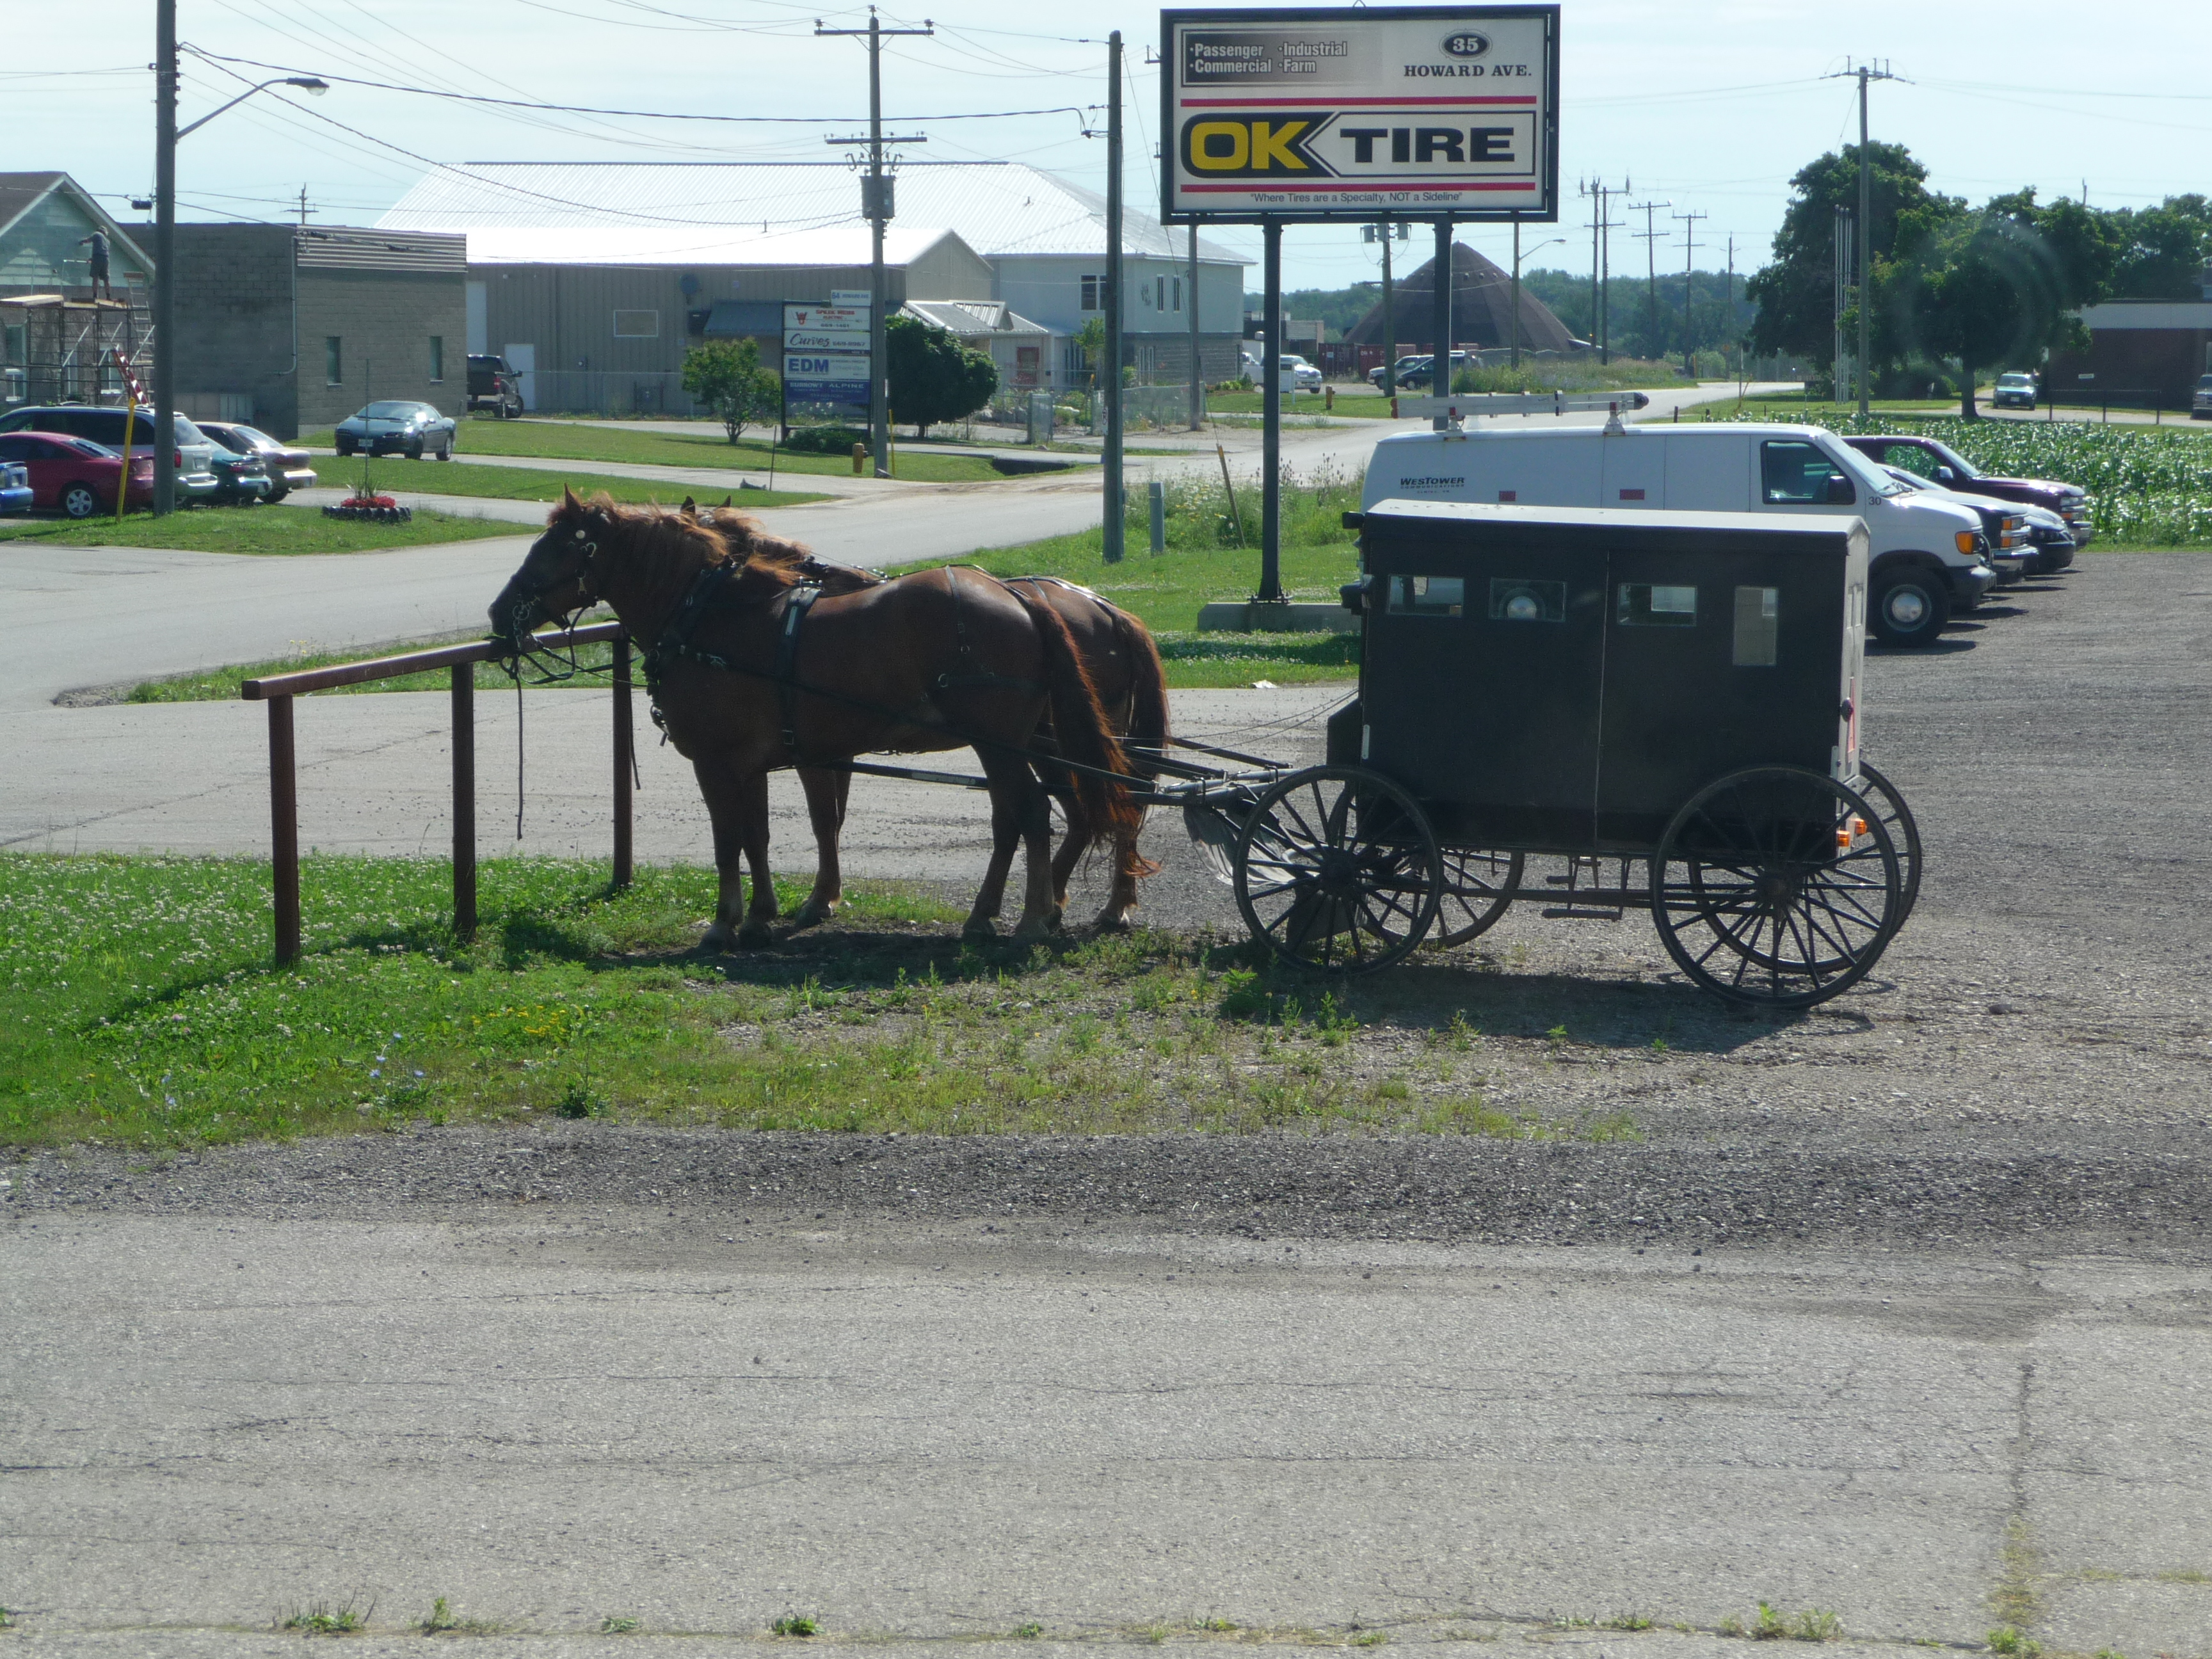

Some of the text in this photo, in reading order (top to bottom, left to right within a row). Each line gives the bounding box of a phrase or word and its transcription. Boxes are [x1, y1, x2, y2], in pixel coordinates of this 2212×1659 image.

[1194, 42, 1347, 59] Passenger Industrial
[1453, 38, 1479, 52] 35
[1194, 58, 1316, 73] Commercial Farm
[1404, 65, 1532, 77] HOWARD AVE.
[1190, 121, 1515, 170] OK TIRE
[1287, 193, 1310, 202] Tires
[1341, 192, 1386, 204] Specialty,
[1390, 192, 1411, 201] NOT
[1423, 192, 1463, 201] Sideline"
[790, 333, 830, 347] Curves
[788, 358, 830, 373] EDM
[1400, 477, 1465, 486] WESTOWER
[1869, 496, 1881, 506] 30
